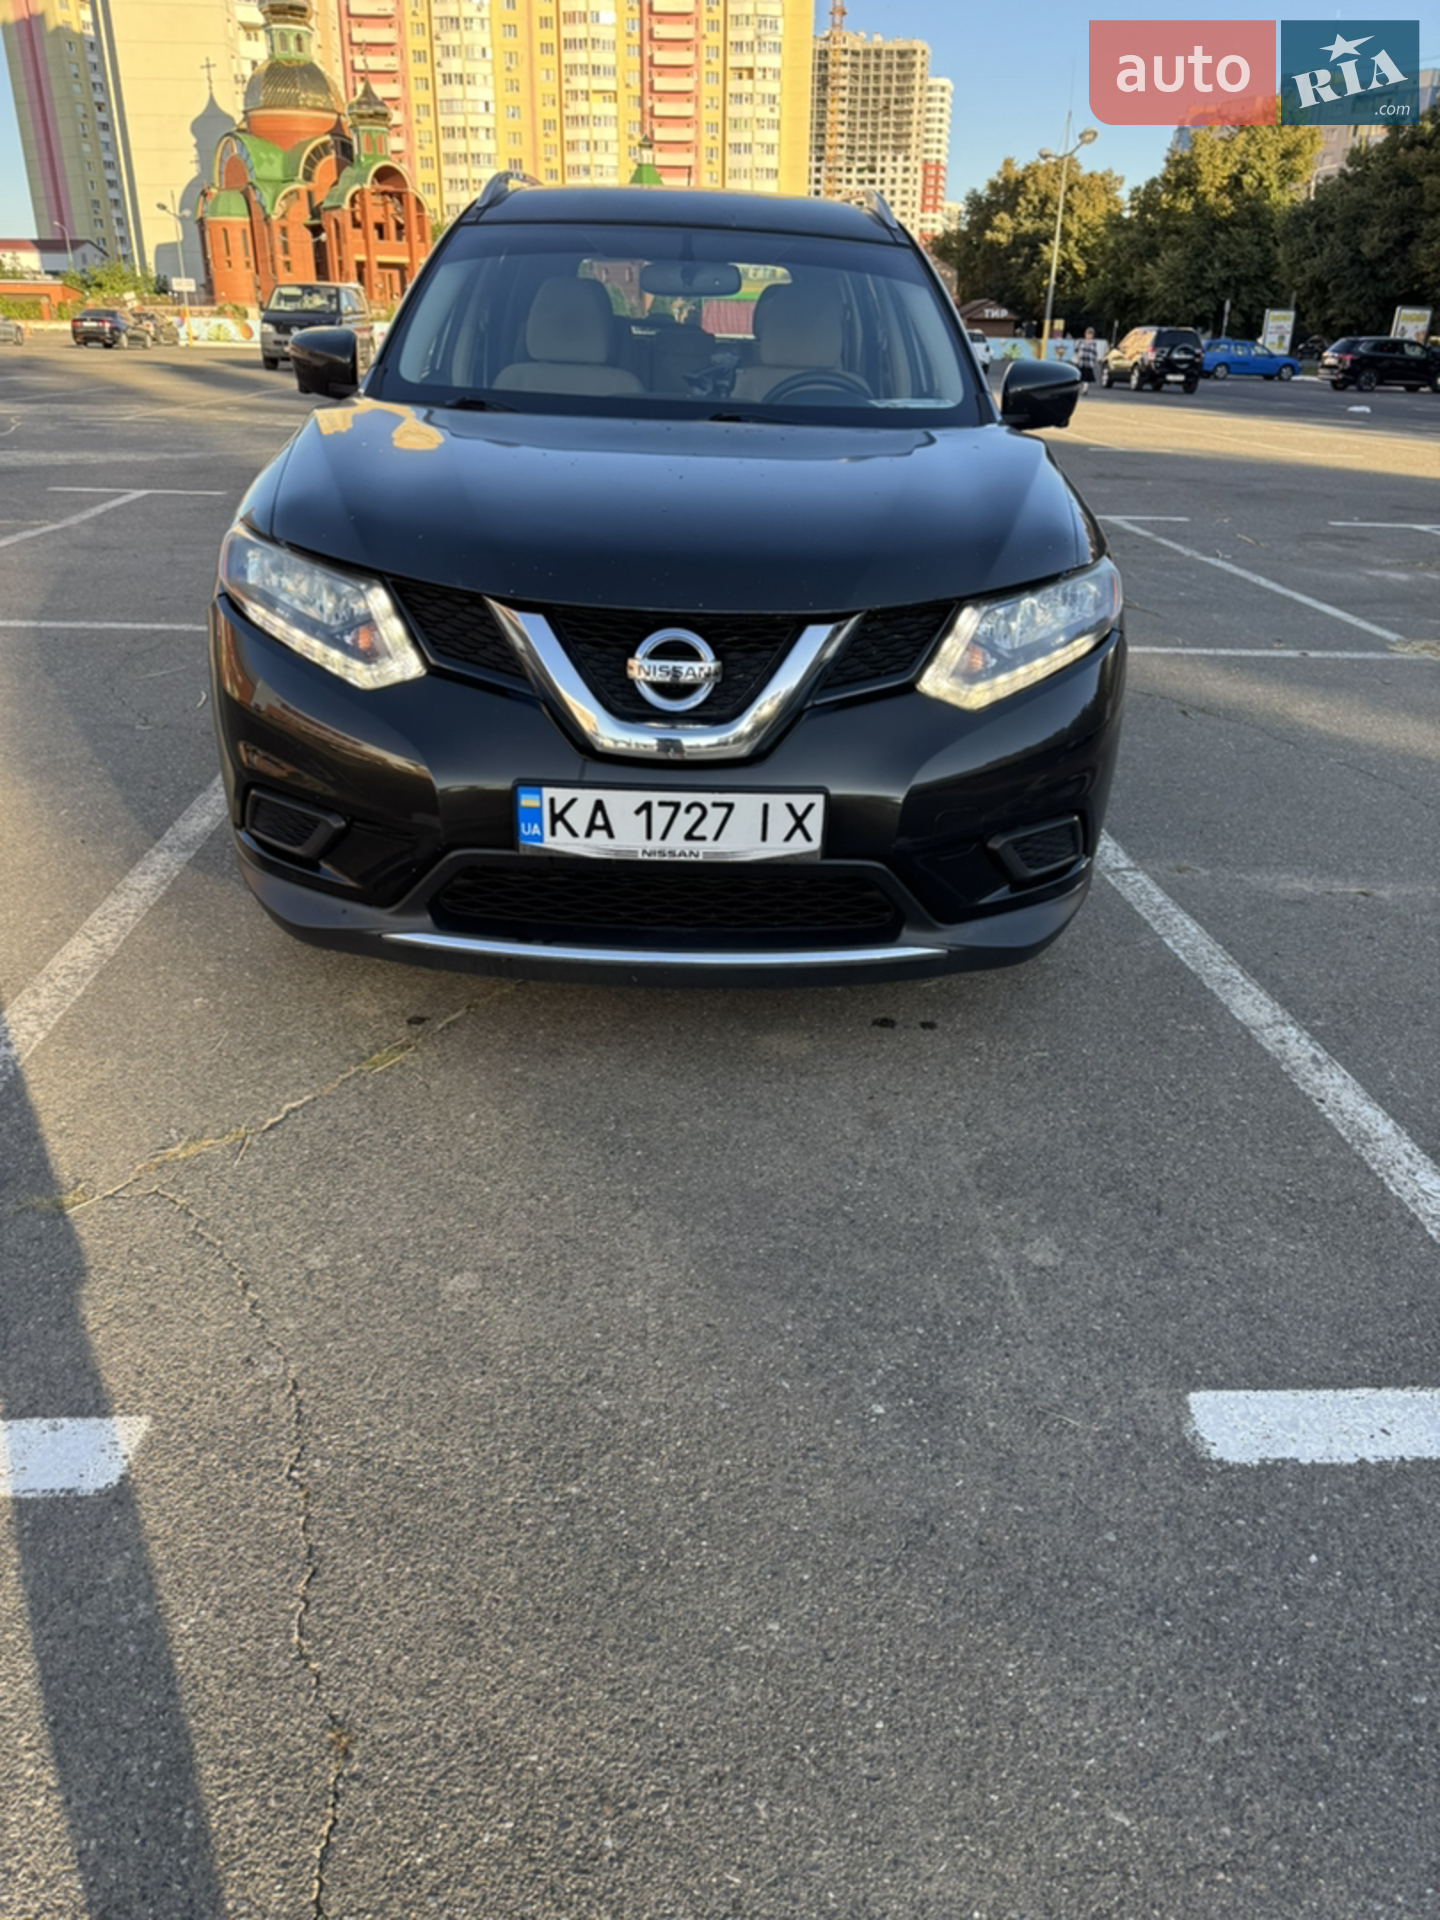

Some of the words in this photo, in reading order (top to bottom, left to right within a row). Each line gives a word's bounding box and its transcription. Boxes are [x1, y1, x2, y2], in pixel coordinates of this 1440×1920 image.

[637, 664, 712, 679] NISSAN
[548, 796, 615, 839] KA
[633, 800, 736, 842] 1727
[760, 802, 816, 842] IX
[521, 822, 542, 836] UA
[641, 849, 700, 859] NISSAN
